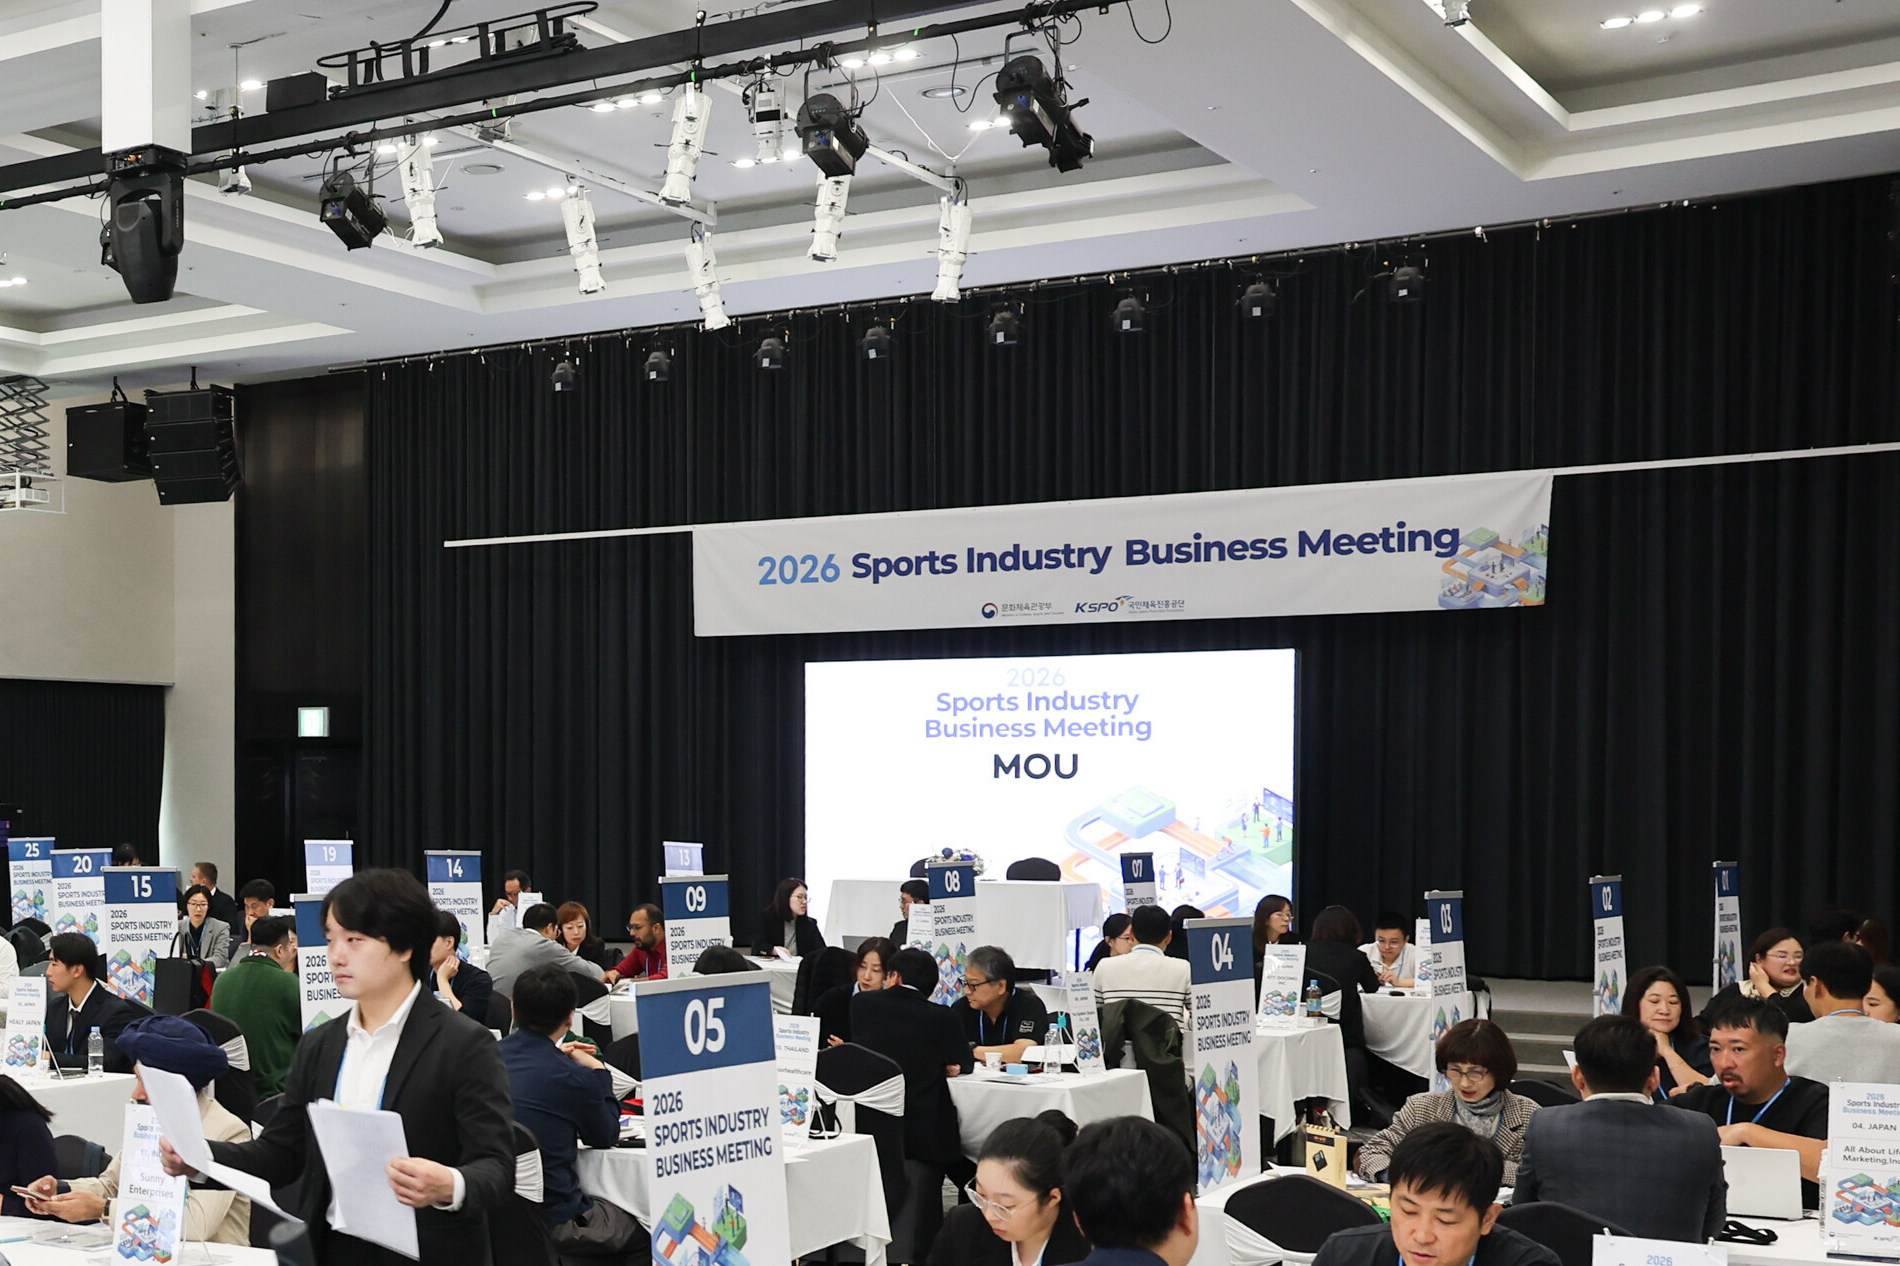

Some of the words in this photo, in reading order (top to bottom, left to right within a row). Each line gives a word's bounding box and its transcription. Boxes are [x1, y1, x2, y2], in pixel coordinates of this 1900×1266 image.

[757, 553, 841, 586] 2026
[851, 550, 958, 584] Sports
[966, 543, 1113, 575] Industry
[1125, 533, 1288, 566] Business
[1297, 521, 1461, 558] Meeting
[1001, 602, 1053, 613] 문화체육관광부
[1074, 602, 1119, 614] KSPO
[1128, 600, 1185, 610] 국민체육진흥공단
[1006, 667, 1066, 688] 2026
[936, 691, 1019, 717] Sports
[1026, 690, 1139, 715] Industry
[925, 717, 1036, 739] Business
[1043, 714, 1152, 742] Meeting
[993, 753, 1078, 779] MOU
[24, 843, 40, 858] 25
[322, 846, 337, 862] 19
[679, 849, 690, 866] 13
[72, 855, 92, 873] 20
[446, 858, 464, 878] 14
[1132, 859, 1143, 878] 07
[130, 875, 152, 898] 15
[944, 870, 961, 893] 08
[58, 891, 80, 899] SPORTS
[685, 886, 706, 912] 09
[1602, 886, 1612, 911] 02
[110, 910, 128, 918] 2026
[1440, 903, 1452, 934] 03
[110, 921, 137, 931] SPORTS
[138, 920, 172, 930] INDUSTRY
[670, 926, 685, 936] 2026
[110, 932, 143, 942] BUSINESS
[144, 932, 174, 942] MEETING
[670, 940, 694, 950] SPORTS
[1212, 932, 1234, 972] 04
[306, 955, 327, 968] 2026
[1196, 994, 1212, 1010] 2026
[684, 997, 726, 1056] 05
[1197, 1014, 1221, 1031] SPORTS
[1221, 1010, 1250, 1028] INDUSTRY
[1198, 1034, 1226, 1052] BUSINESS
[1226, 1030, 1252, 1047] MEETING
[652, 1090, 684, 1116] 2026
[1842, 1106, 1876, 1114] Business
[1846, 1100, 1871, 1108] Sports
[654, 1118, 702, 1148] SPORTS
[705, 1107, 770, 1137] INDUSTRY
[1868, 1123, 1897, 1132] JAPAN
[656, 1146, 714, 1178] BUSINESS
[716, 1136, 773, 1166] MEETING
[1858, 1146, 1885, 1154] About
[140, 1172, 165, 1186] Sunny
[129, 1184, 174, 1200] Enterprises
[1646, 1254, 1673, 1266] 2026
